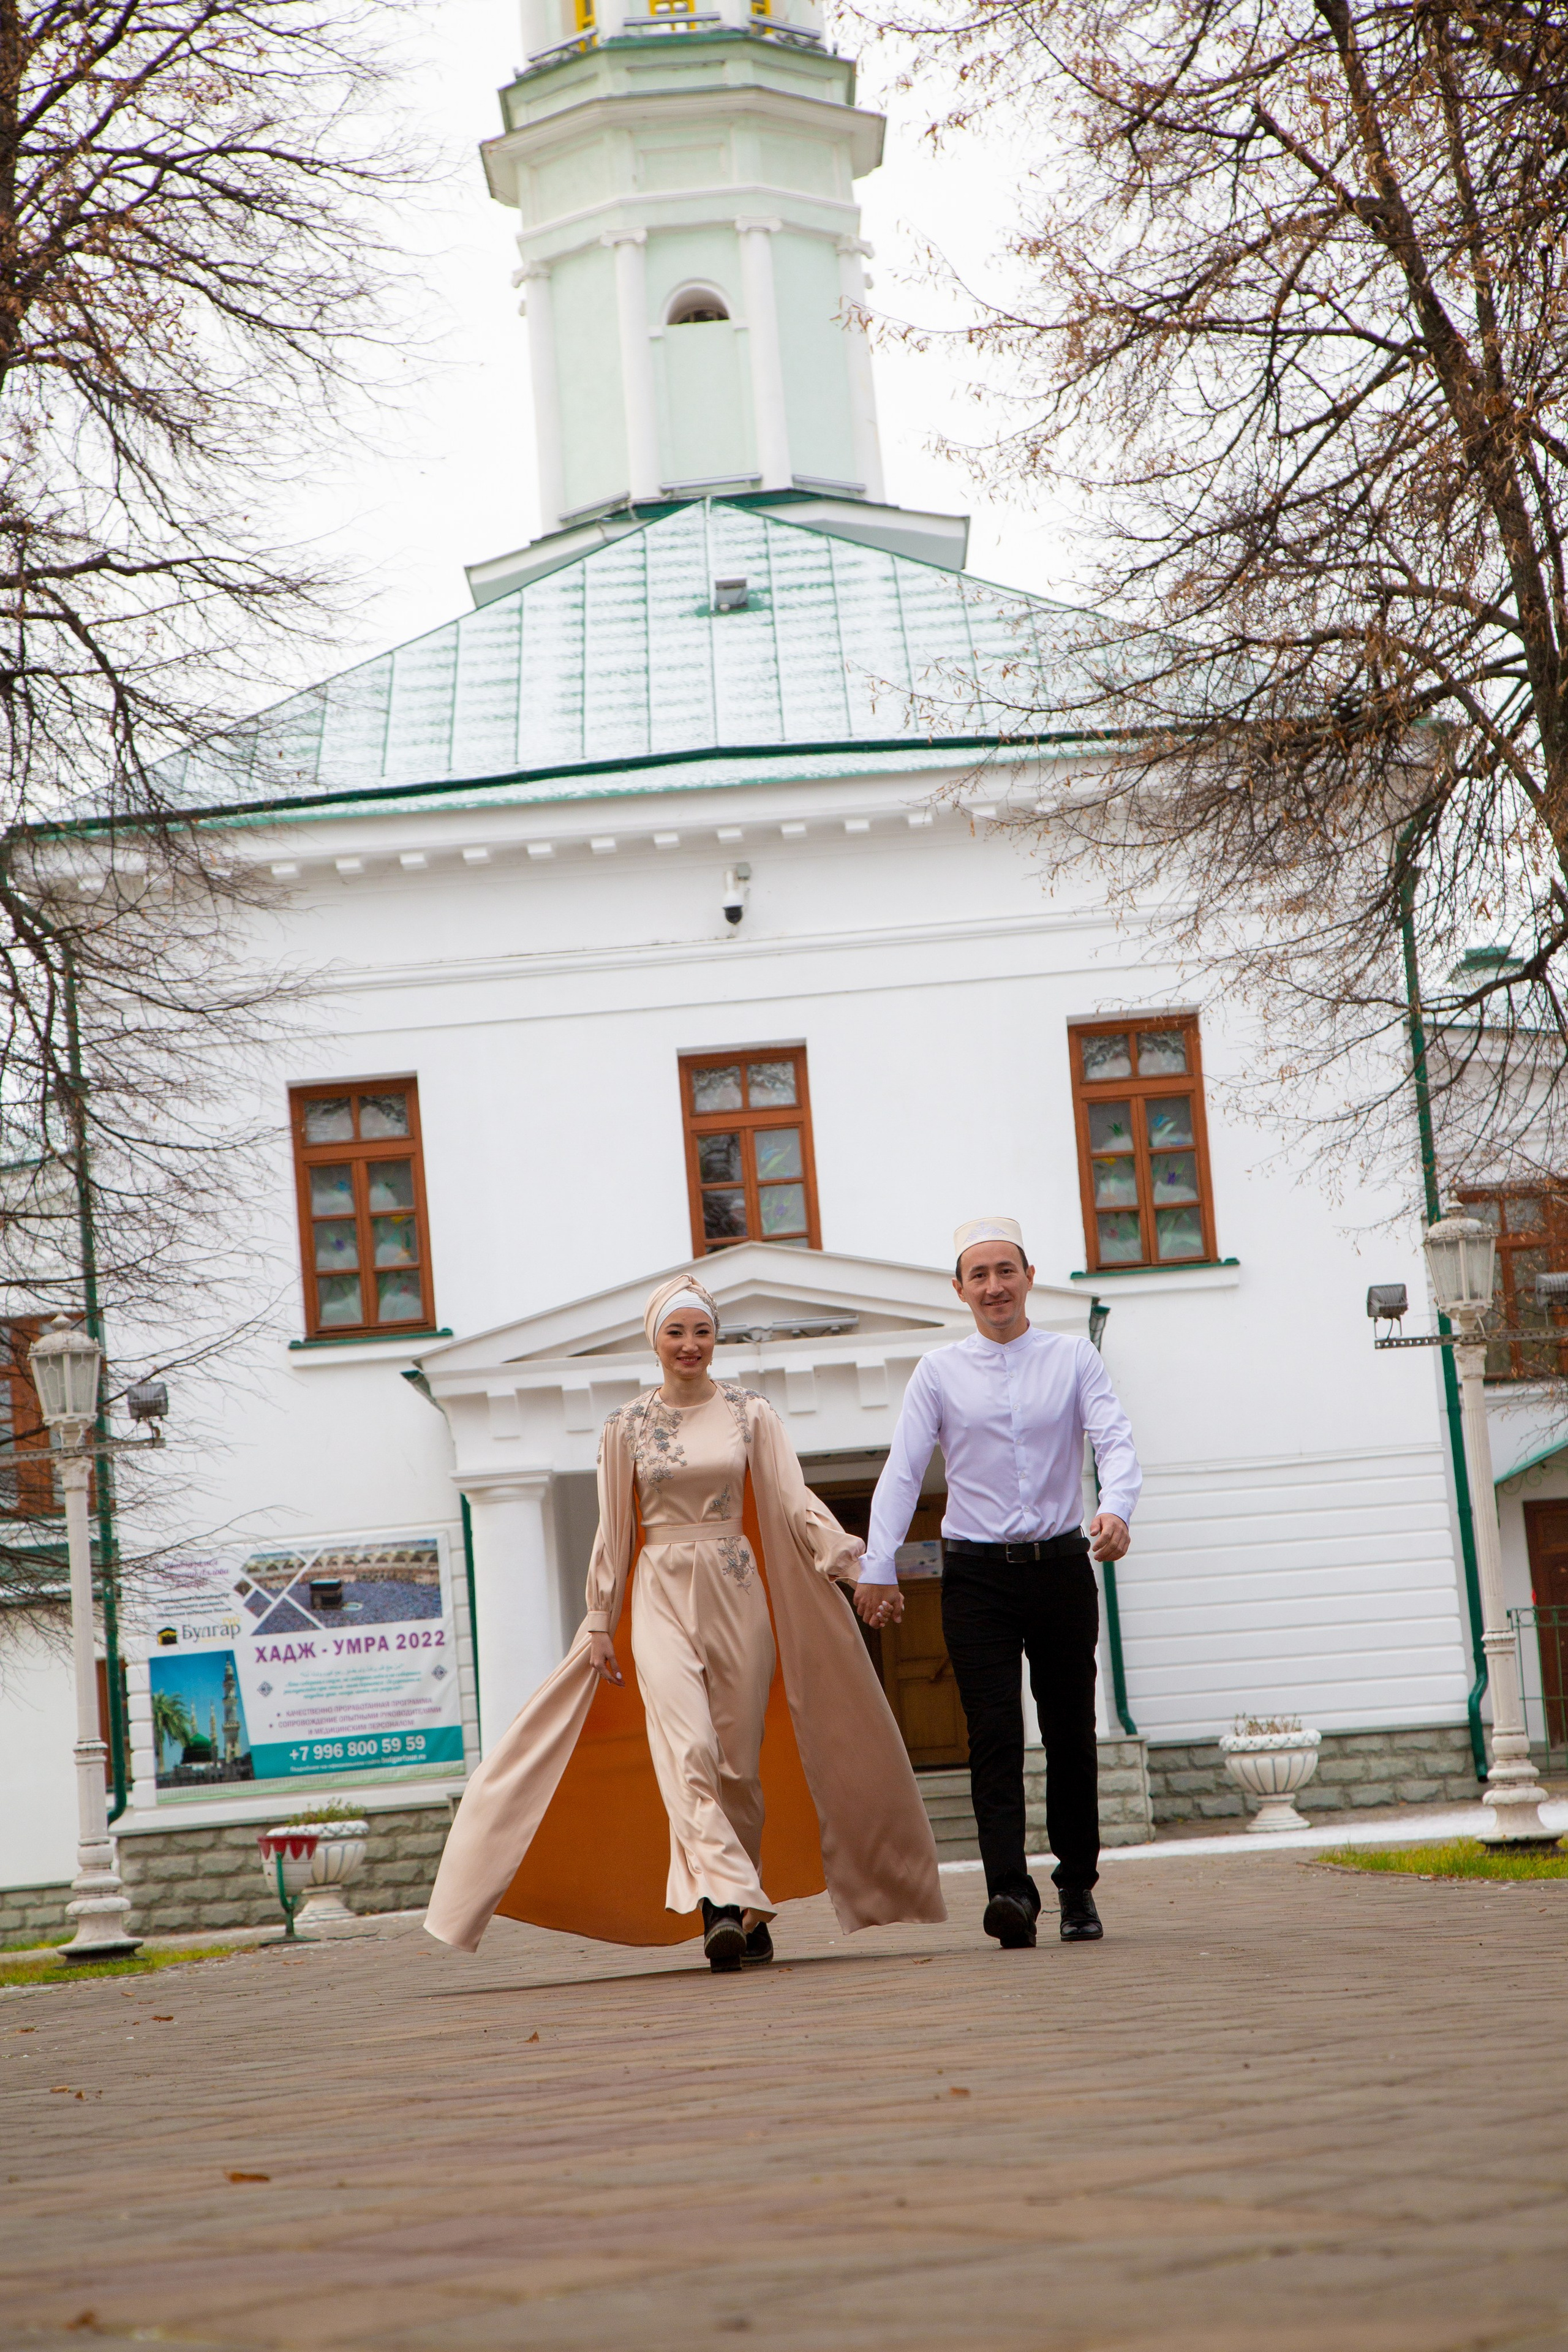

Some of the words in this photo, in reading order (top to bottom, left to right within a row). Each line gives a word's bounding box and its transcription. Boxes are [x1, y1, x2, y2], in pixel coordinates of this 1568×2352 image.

[182, 1624, 241, 1642] Булгар
[255, 1642, 316, 1664] ХАДЖ
[333, 1635, 390, 1656] УМРА
[396, 1629, 445, 1649] 2022
[286, 1708, 333, 1717] КАЧЕСТВЕННО
[278, 1717, 338, 1728] СОПРОВОЖДЕНИЕ
[289, 1746, 309, 1762] +7
[313, 1743, 343, 1760] 996
[347, 1740, 377, 1756] 800
[382, 1736, 402, 1753] 59
[405, 1735, 426, 1751] 59
